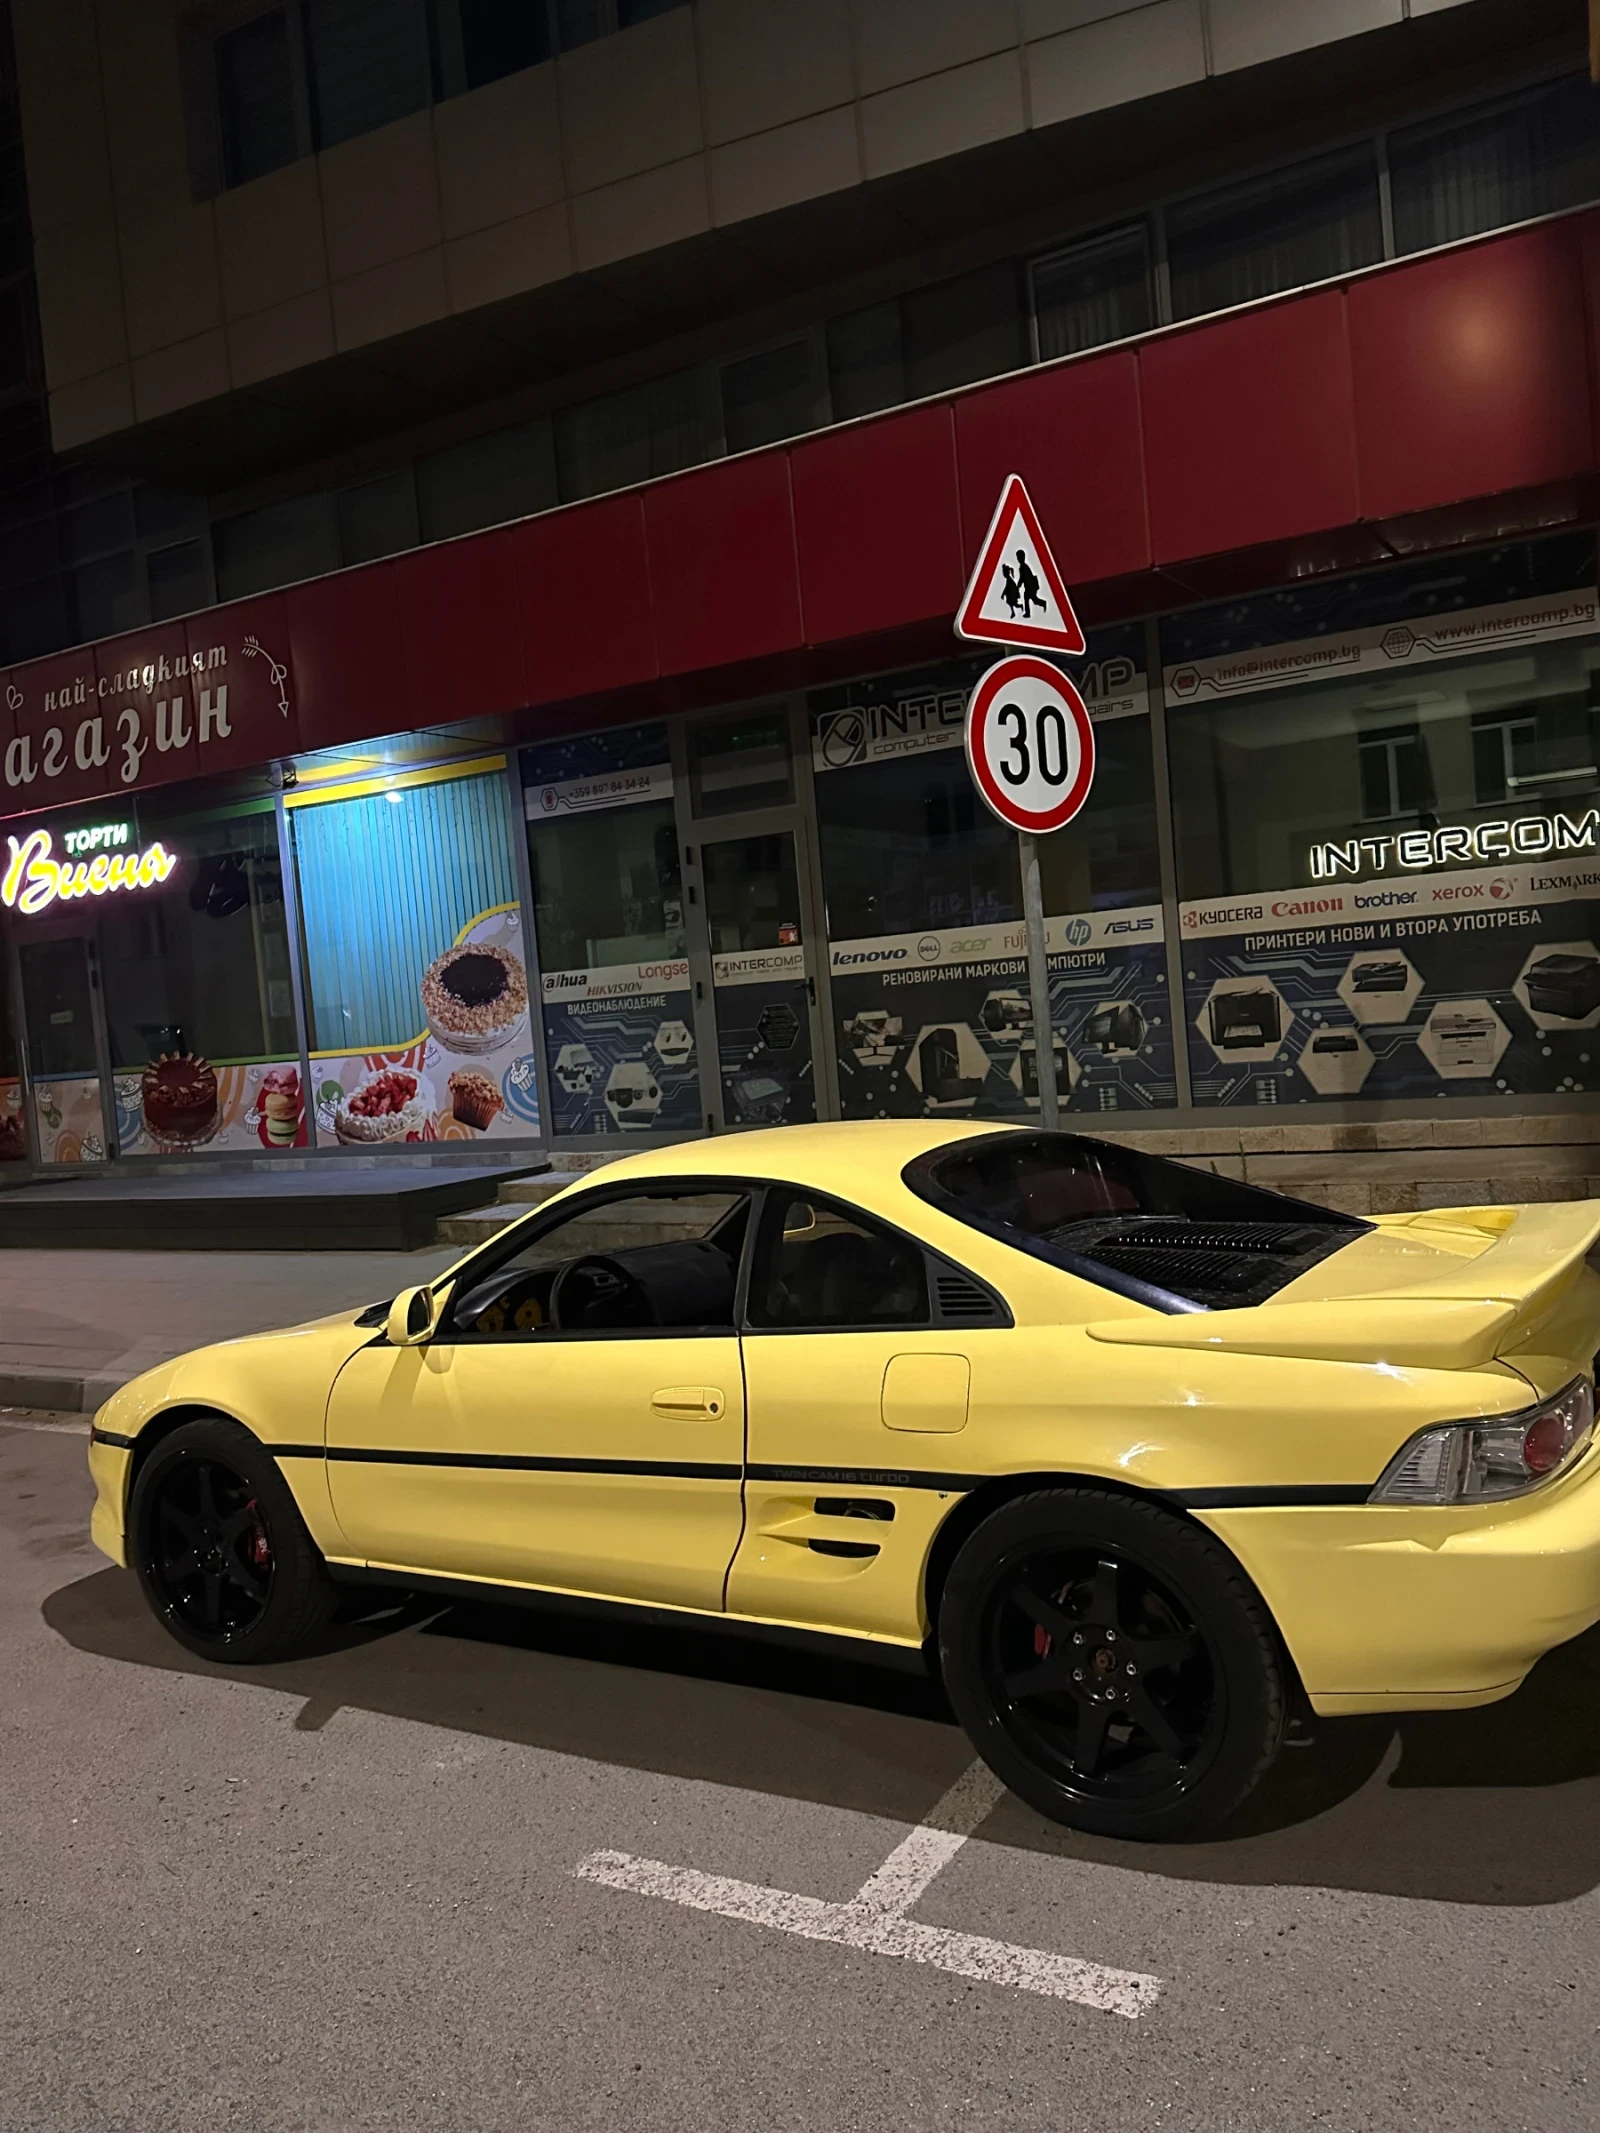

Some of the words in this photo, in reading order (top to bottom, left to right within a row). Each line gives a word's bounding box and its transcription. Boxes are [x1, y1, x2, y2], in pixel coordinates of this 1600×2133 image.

[1434, 603, 1596, 641] www.intercomp.bg
[44, 645, 228, 712] най-сладкият
[1217, 644, 1362, 681] info@intercomp.bg
[867, 655, 1137, 739] INTEMP
[0, 685, 233, 787] агазин
[873, 731, 957, 755] computer
[1087, 699, 1134, 716] pairs
[997, 703, 1069, 787] 30
[638, 775, 651, 788] 24
[64, 823, 128, 852] ТОРТИ
[1309, 809, 1600, 879] INTERCOM
[1, 829, 177, 914] Виена
[1270, 897, 1343, 918] Canon
[1354, 888, 1418, 909] brother
[1432, 883, 1485, 901] xerox
[832, 948, 908, 966] lenovo
[919, 945, 938, 953] DELL
[950, 937, 993, 954] acer
[1004, 930, 1051, 951] FUJIU
[1068, 919, 1090, 947] hp
[1103, 918, 1155, 935] ASUS
[1244, 929, 1327, 951] ПРИНТЕРИ
[1330, 924, 1376, 944] НОВИ
[1380, 923, 1392, 939] И
[1396, 918, 1449, 937] ВТОРА
[1452, 909, 1543, 932] УПОТРЕБА
[638, 962, 688, 981] Longse
[729, 955, 803, 972] INTERCOMP
[882, 968, 962, 987] РЕНОВИРАНИ
[965, 960, 1027, 979] МАРКОВИ
[1047, 951, 1106, 971] МПЮТРИ
[567, 995, 667, 1016] ВИДЕОНАБЛЮДЕНИЕ
[586, 981, 643, 997] HIKVISION
[771, 1469, 808, 1480] TWIN
[808, 1471, 839, 1481] CAM
